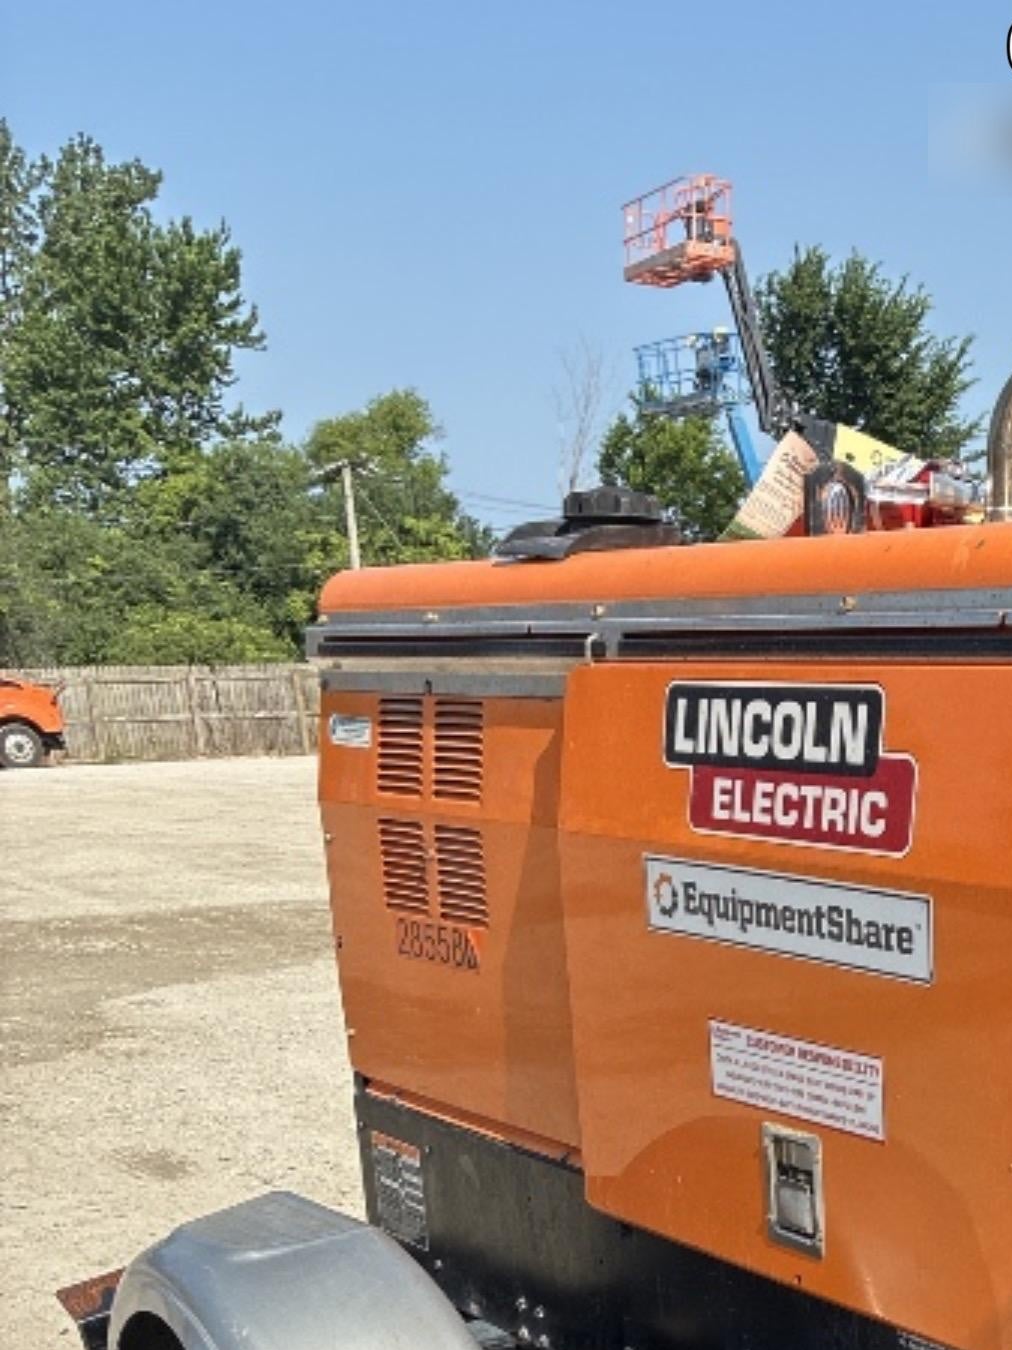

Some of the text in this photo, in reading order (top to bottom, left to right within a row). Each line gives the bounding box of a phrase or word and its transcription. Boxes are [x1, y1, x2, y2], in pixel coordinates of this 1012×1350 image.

[674, 697, 868, 765] LINCOLN
[712, 776, 888, 838] ELECTRIC
[682, 881, 914, 955] EquipmentShare
